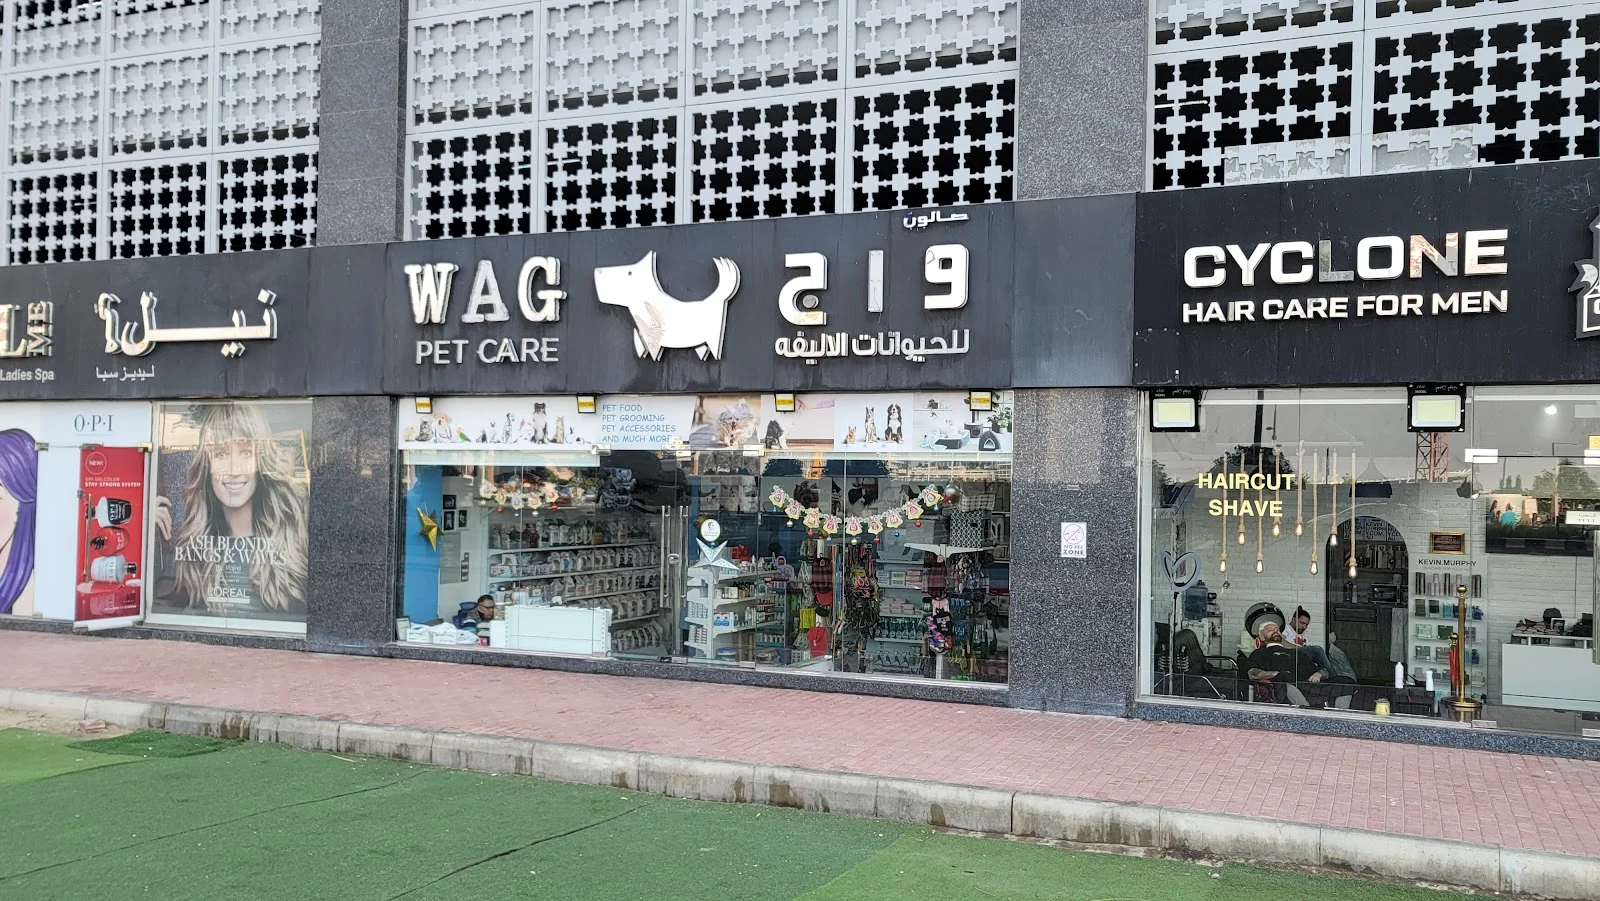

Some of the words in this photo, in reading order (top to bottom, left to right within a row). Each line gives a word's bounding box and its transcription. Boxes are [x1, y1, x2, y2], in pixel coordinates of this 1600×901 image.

[903, 211, 969, 231] صالون
[1184, 229, 1508, 289] CYCLONE
[404, 256, 567, 325] WAG
[1182, 300, 1255, 323] HAIR
[1263, 297, 1349, 321] CARE
[1357, 294, 1423, 317] FOR
[1432, 289, 1508, 315] MEN
[416, 338, 469, 365] PET
[477, 337, 560, 364] CARE
[852, 329, 970, 362] للحيوانات
[0, 368, 32, 381] Ladies
[34, 368, 55, 383] Spa
[95, 366, 118, 381] سبا
[602, 404, 617, 412] PET
[620, 404, 643, 412] FOOD
[620, 414, 665, 422] GROOMING
[620, 425, 676, 433] ACCESSORIES
[602, 435, 620, 443] AND
[622, 435, 646, 443] MUCH
[1198, 473, 1295, 490] HAIRCUT
[1208, 499, 1283, 517] SHAVE
[187, 535, 215, 550] ASH
[217, 536, 276, 552] BLONDE
[174, 547, 221, 563] BANGS
[223, 549, 236, 563] &
[239, 549, 287, 565] WAVES
[1418, 558, 1477, 567] KEVIN.MURPHY
